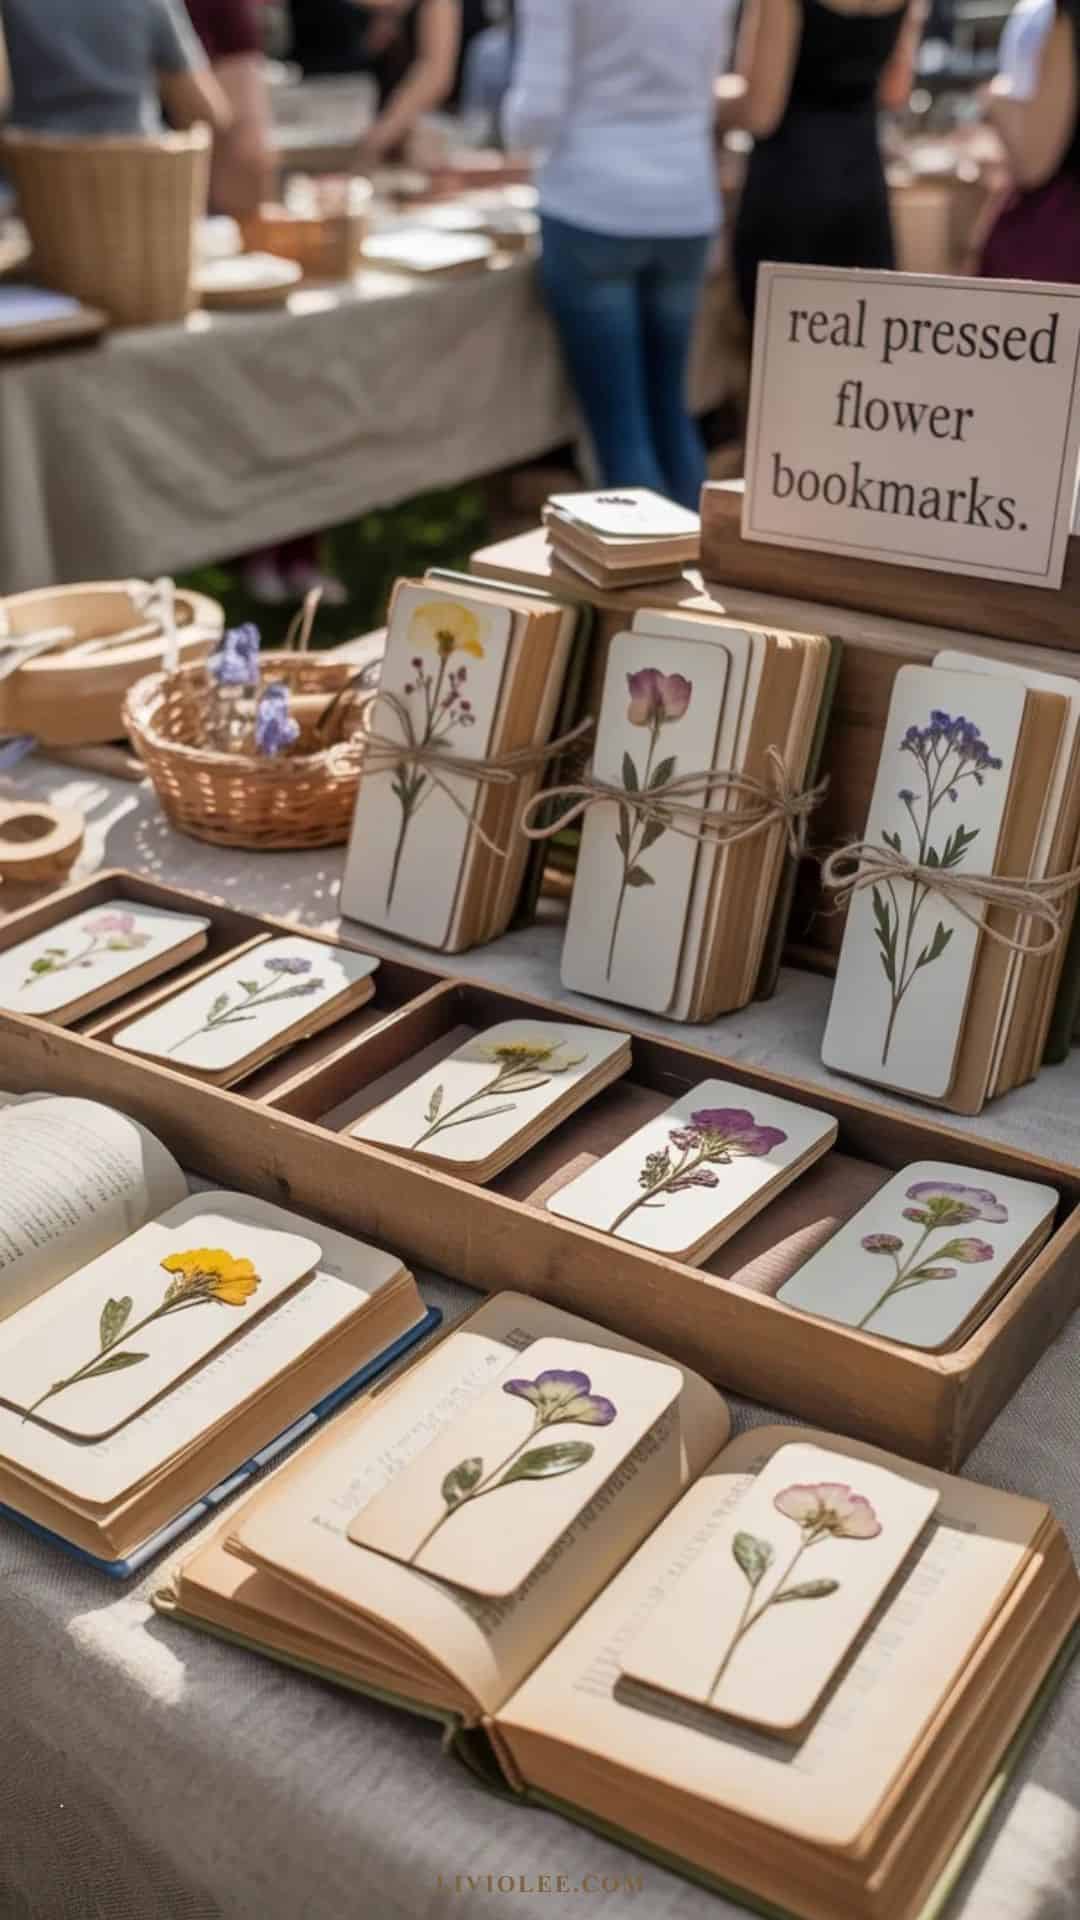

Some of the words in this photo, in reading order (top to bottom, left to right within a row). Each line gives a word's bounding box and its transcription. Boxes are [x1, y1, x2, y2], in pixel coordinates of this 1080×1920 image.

[788, 298, 867, 349] real
[880, 312, 1060, 365] pressed
[833, 380, 975, 442] flower
[771, 452, 1029, 532] bookmarks.
